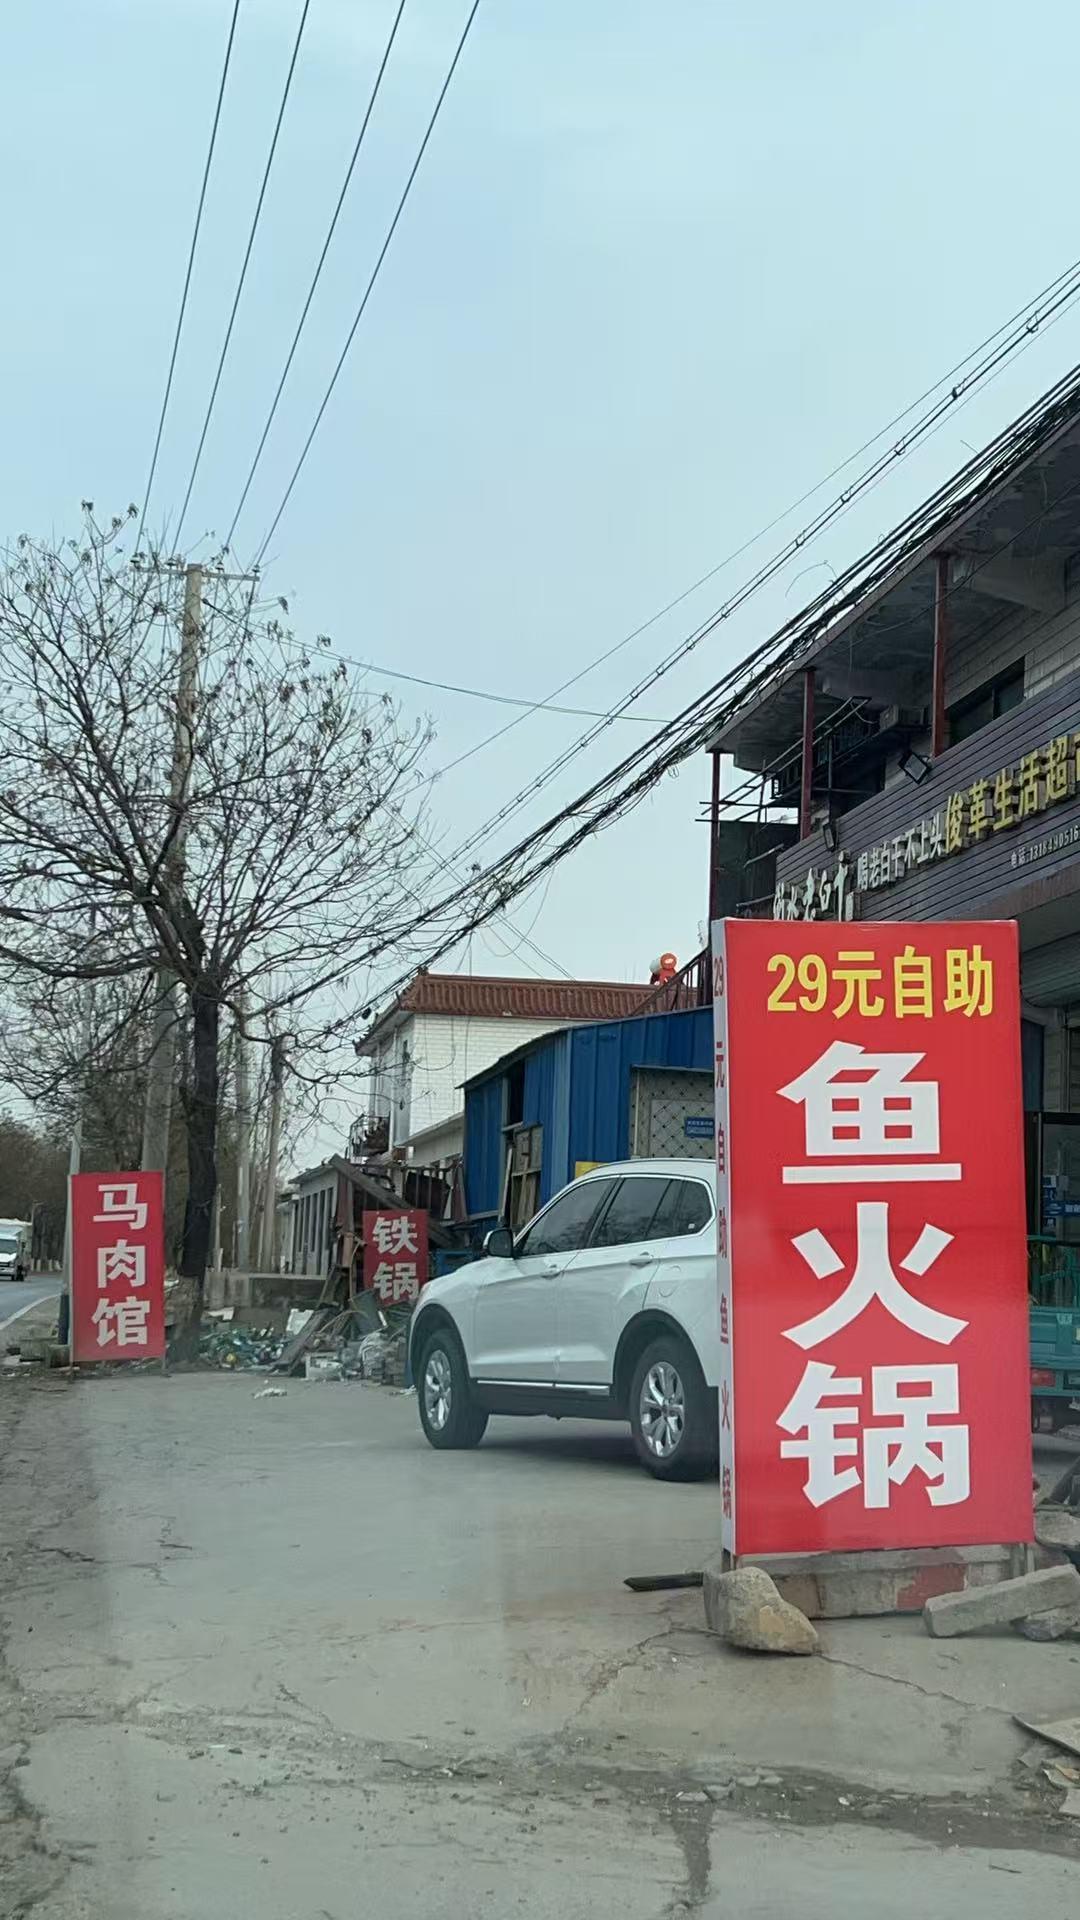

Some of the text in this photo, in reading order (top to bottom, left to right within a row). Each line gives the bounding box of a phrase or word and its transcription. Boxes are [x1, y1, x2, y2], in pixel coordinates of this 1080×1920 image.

[767, 944, 993, 1019] 29元自助
[92, 1183, 151, 1348] 马肉馆
[372, 1215, 420, 1302] 铁锅
[776, 1040, 970, 1508] 鱼火锅
